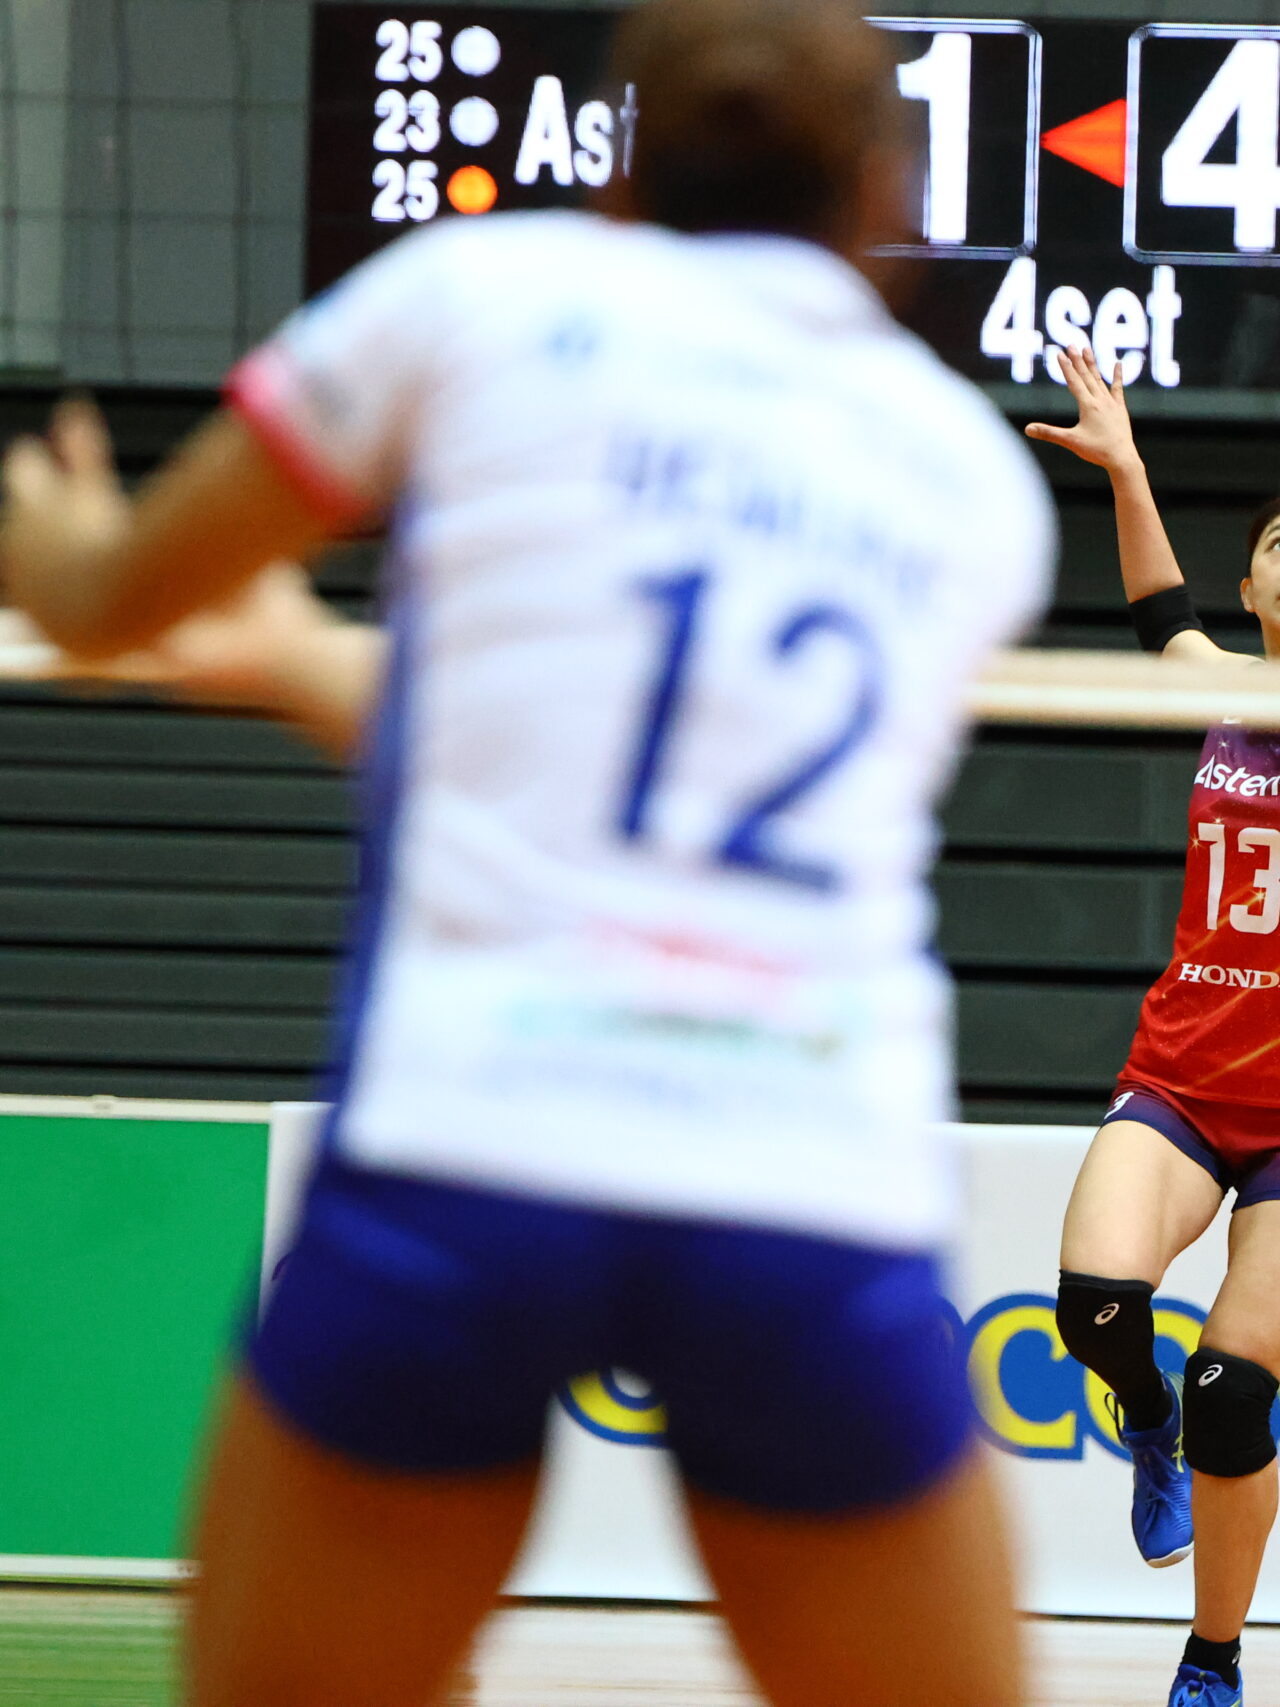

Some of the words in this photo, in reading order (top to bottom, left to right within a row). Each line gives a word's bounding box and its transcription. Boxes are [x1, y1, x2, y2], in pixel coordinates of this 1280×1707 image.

[375, 19, 442, 82] 25
[373, 89, 440, 152] 23
[897, 33, 971, 244] 1
[371, 159, 438, 222] 25
[980, 256, 1182, 387] 4set
[620, 565, 888, 890] 12
